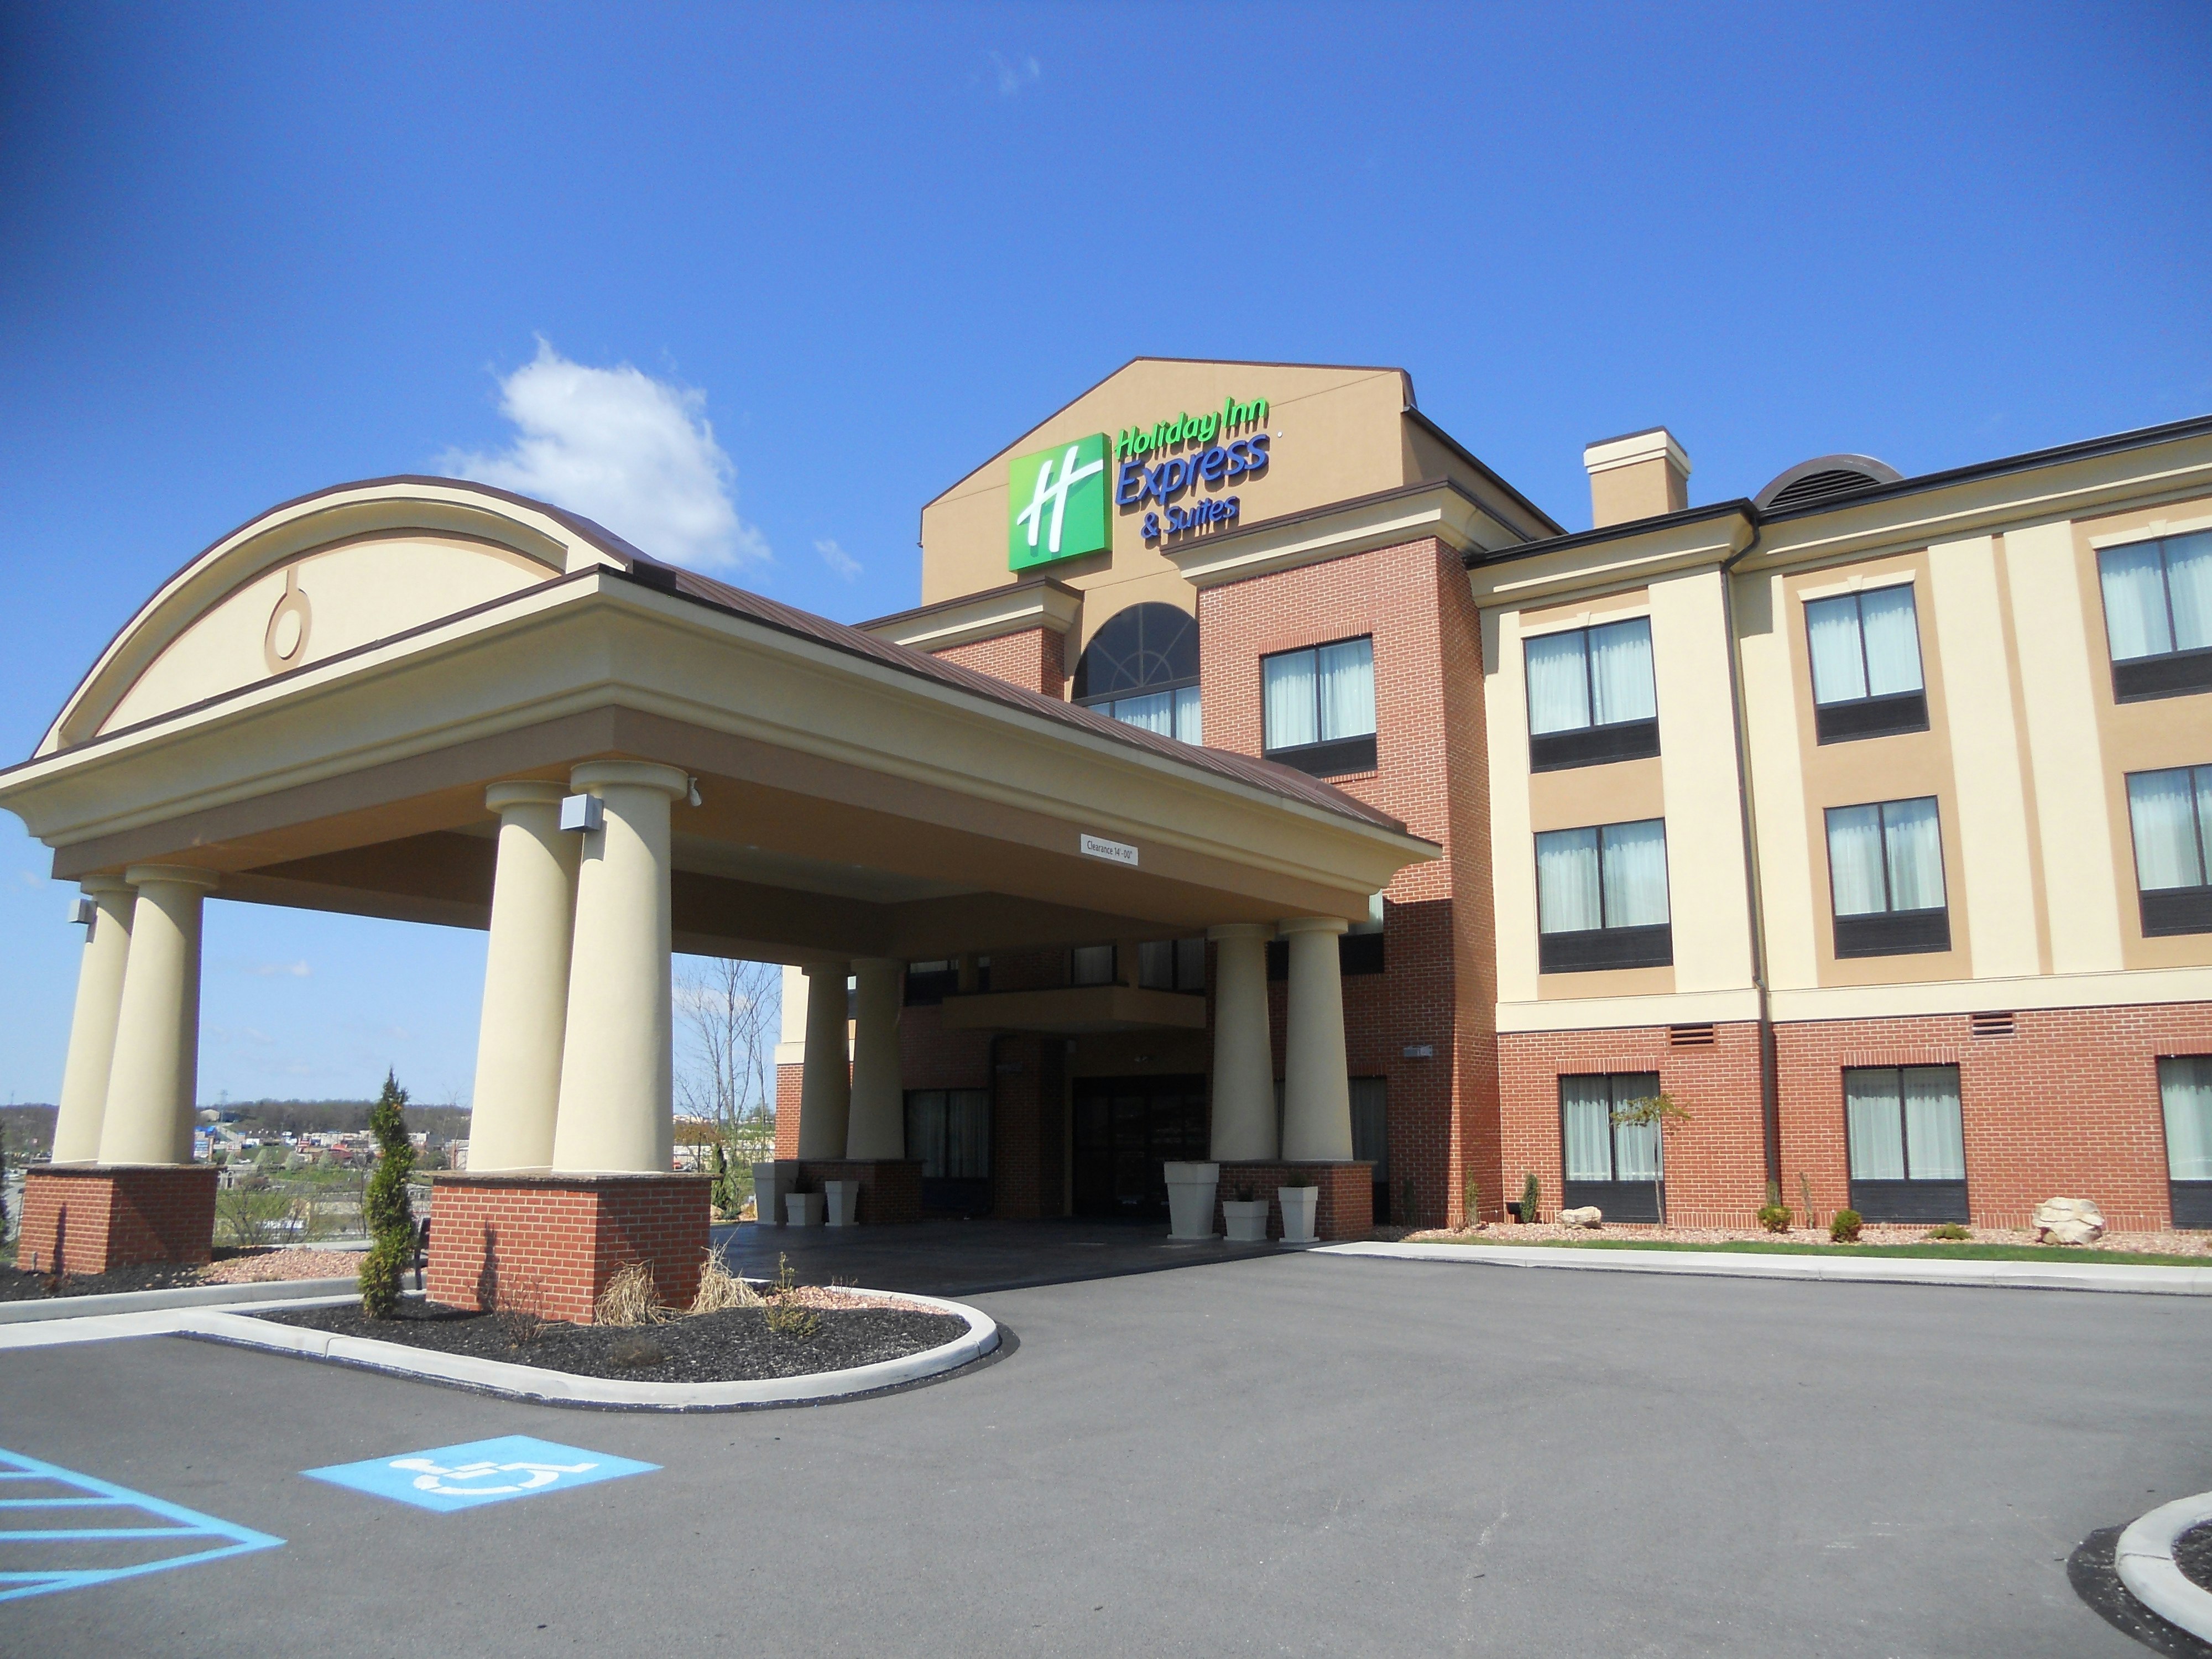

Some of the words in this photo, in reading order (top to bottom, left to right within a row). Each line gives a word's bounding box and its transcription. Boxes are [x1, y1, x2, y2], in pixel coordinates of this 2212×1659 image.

[1114, 411, 1218, 458] Holiday
[1222, 397, 1267, 427] Inn
[1115, 434, 1269, 506] Express
[1141, 512, 1159, 539] &
[1164, 496, 1238, 535] Suites
[1087, 840, 1113, 855] Clearance
